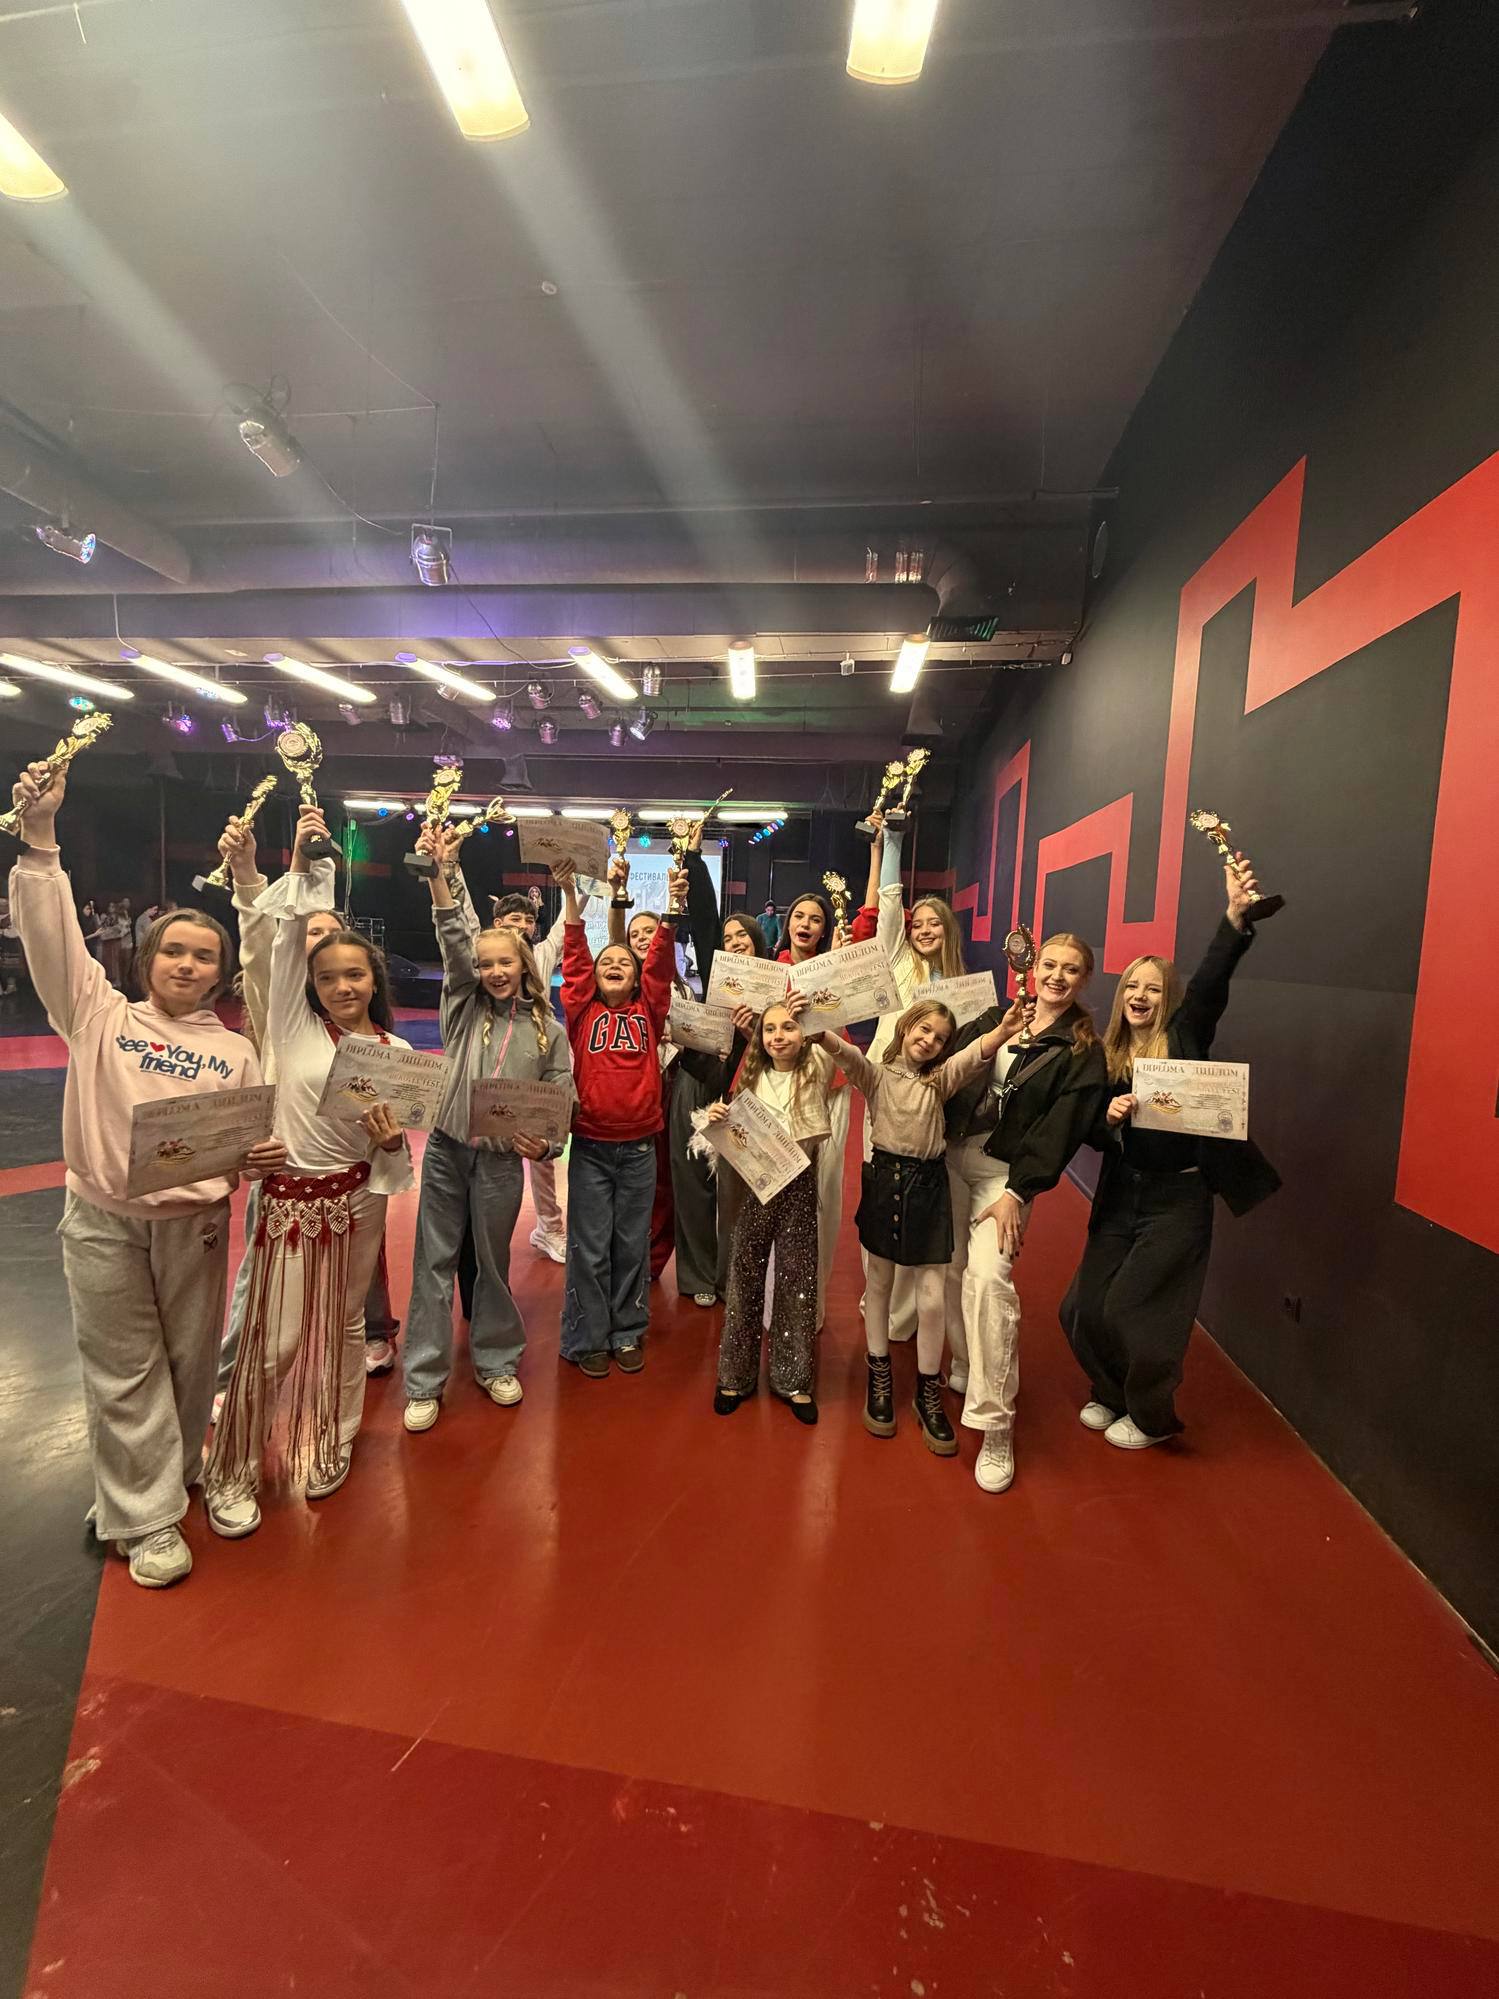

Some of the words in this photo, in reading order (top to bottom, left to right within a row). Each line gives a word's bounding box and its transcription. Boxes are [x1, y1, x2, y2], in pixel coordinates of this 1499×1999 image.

[629, 872, 668, 882] ЕСТИВАЛ
[796, 959, 833, 977] DIPLOMA
[115, 1034, 149, 1053] See
[166, 1044, 206, 1070] You,
[207, 1055, 234, 1079] My
[345, 1043, 391, 1060] DIPLOMA
[139, 1052, 201, 1080] friend
[1142, 1063, 1185, 1074] DIPLOMA
[743, 1097, 773, 1129] DIPLOMA
